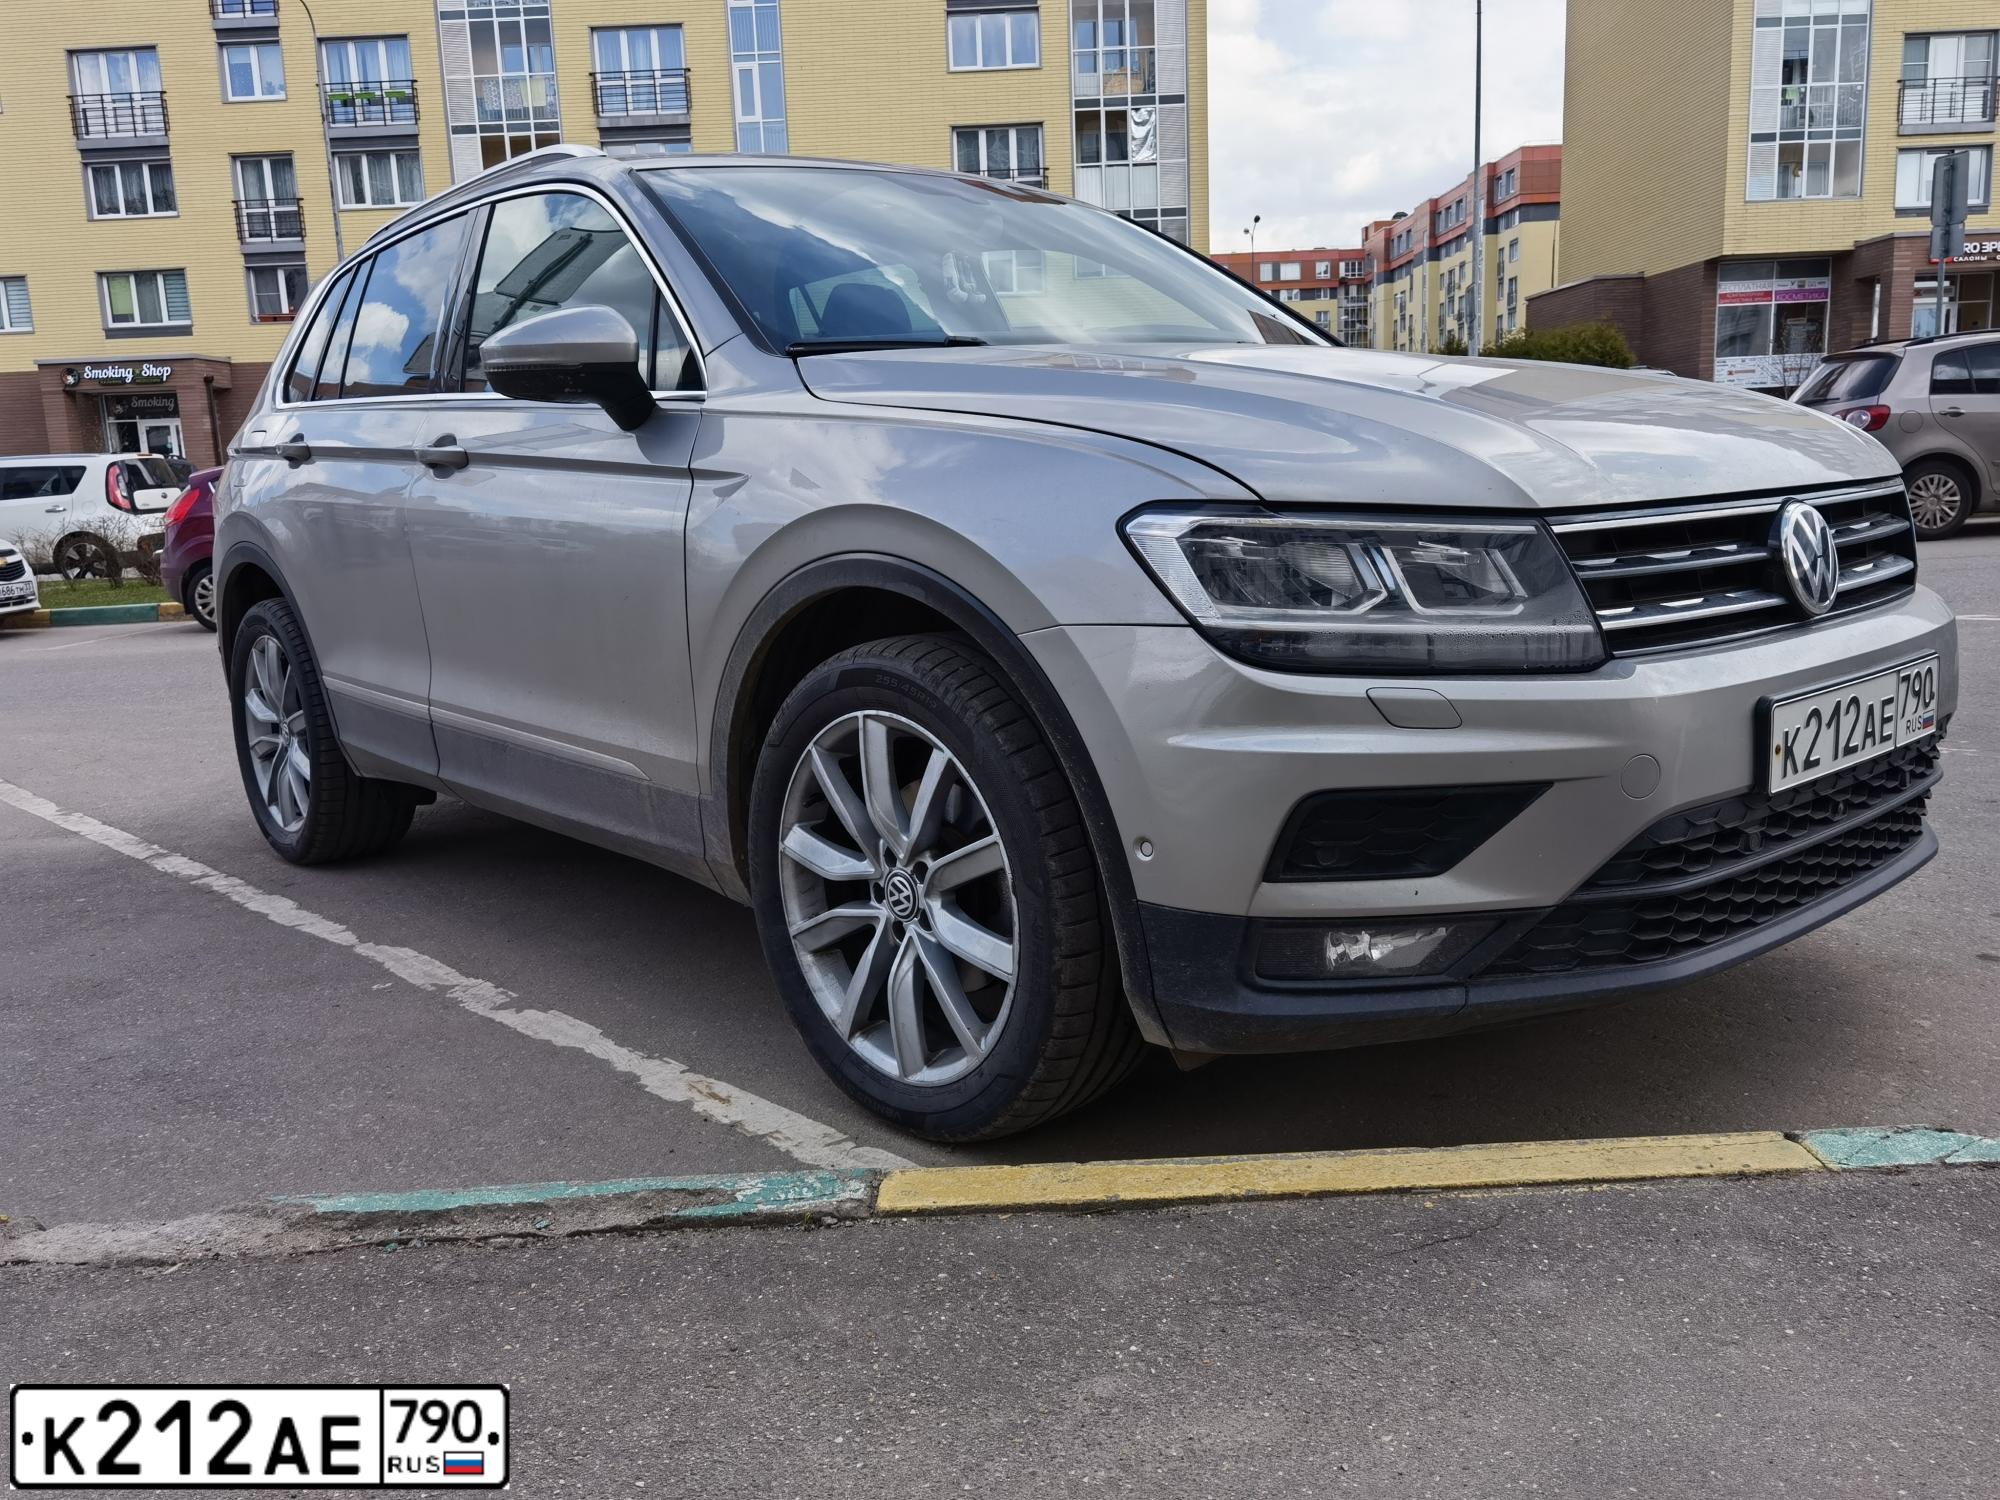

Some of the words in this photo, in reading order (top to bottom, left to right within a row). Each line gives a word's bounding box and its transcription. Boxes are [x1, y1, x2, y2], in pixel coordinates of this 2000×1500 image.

[1953, 255, 1988, 263] САЛОНЫ
[1776, 291, 1826, 302] КОСМЕТИКА
[83, 365, 134, 384] Smoking
[141, 363, 172, 382] Shop
[130, 395, 175, 412] Smoking
[1782, 694, 1895, 780] К212АЕ
[1899, 665, 1935, 720] 790
[1905, 717, 1923, 736] RUS
